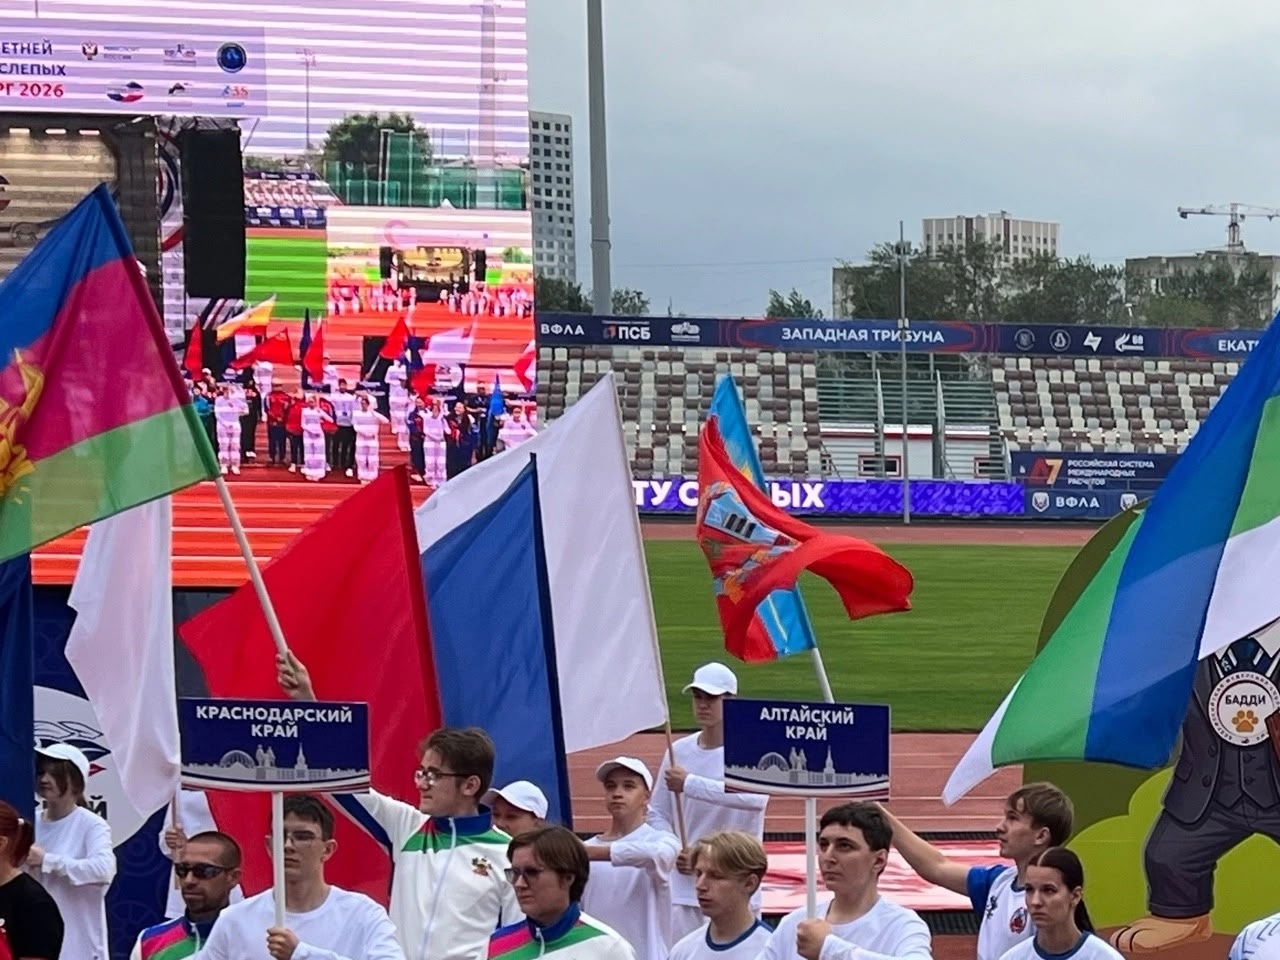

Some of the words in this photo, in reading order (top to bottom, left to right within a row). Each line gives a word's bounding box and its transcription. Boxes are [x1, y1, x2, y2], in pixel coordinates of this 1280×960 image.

[1, 39, 53, 55] ЕТНЕЙ
[0, 62, 66, 76] СЛЕПЫХ
[20, 83, 64, 97] 2026
[540, 323, 585, 336] ВФЛА
[618, 326, 651, 340] ПСБ
[782, 328, 868, 342] ЗАПАДНАЯ
[872, 329, 945, 343] ТРИБУНА
[1218, 339, 1260, 352] ЕКАТ
[1067, 458, 1118, 468] РОССИЙСКАЯ
[1067, 478, 1107, 486] РАСЧТОВ
[1055, 496, 1101, 508] ВФЛА
[1225, 694, 1266, 707] БАДДИ
[196, 705, 353, 723] КРАСНОДАРСКИЙ
[760, 704, 854, 725] АЛТАЙСКИЙ
[251, 721, 298, 738] КРАЙ
[785, 723, 827, 741] КРАЙ
